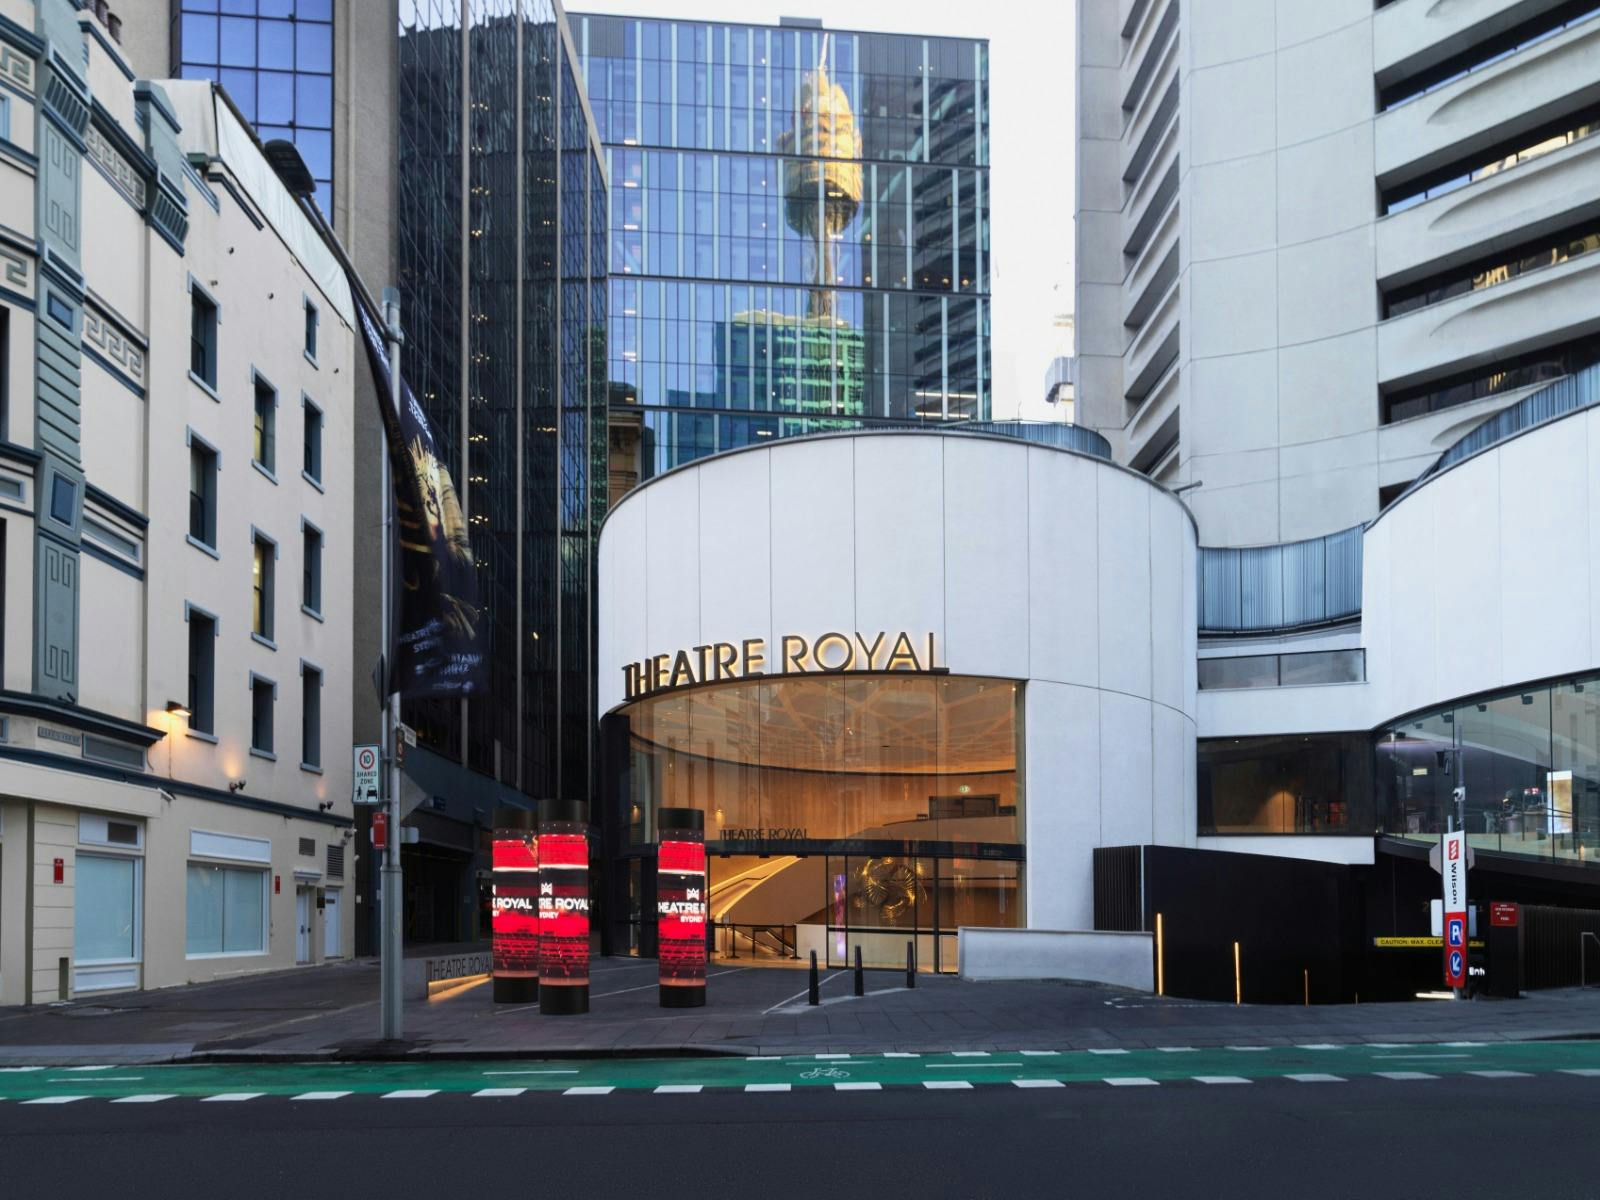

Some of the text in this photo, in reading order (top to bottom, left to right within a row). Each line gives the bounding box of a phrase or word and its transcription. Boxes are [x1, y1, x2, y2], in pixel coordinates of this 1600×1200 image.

[622, 631, 949, 701] THEATRE ROYAL
[363, 754, 371, 765] 10
[719, 828, 808, 840] THEATRE ROYAL
[497, 898, 532, 910] ROYAL
[555, 898, 589, 910] ROYAL
[428, 958, 466, 981] THEATRE
